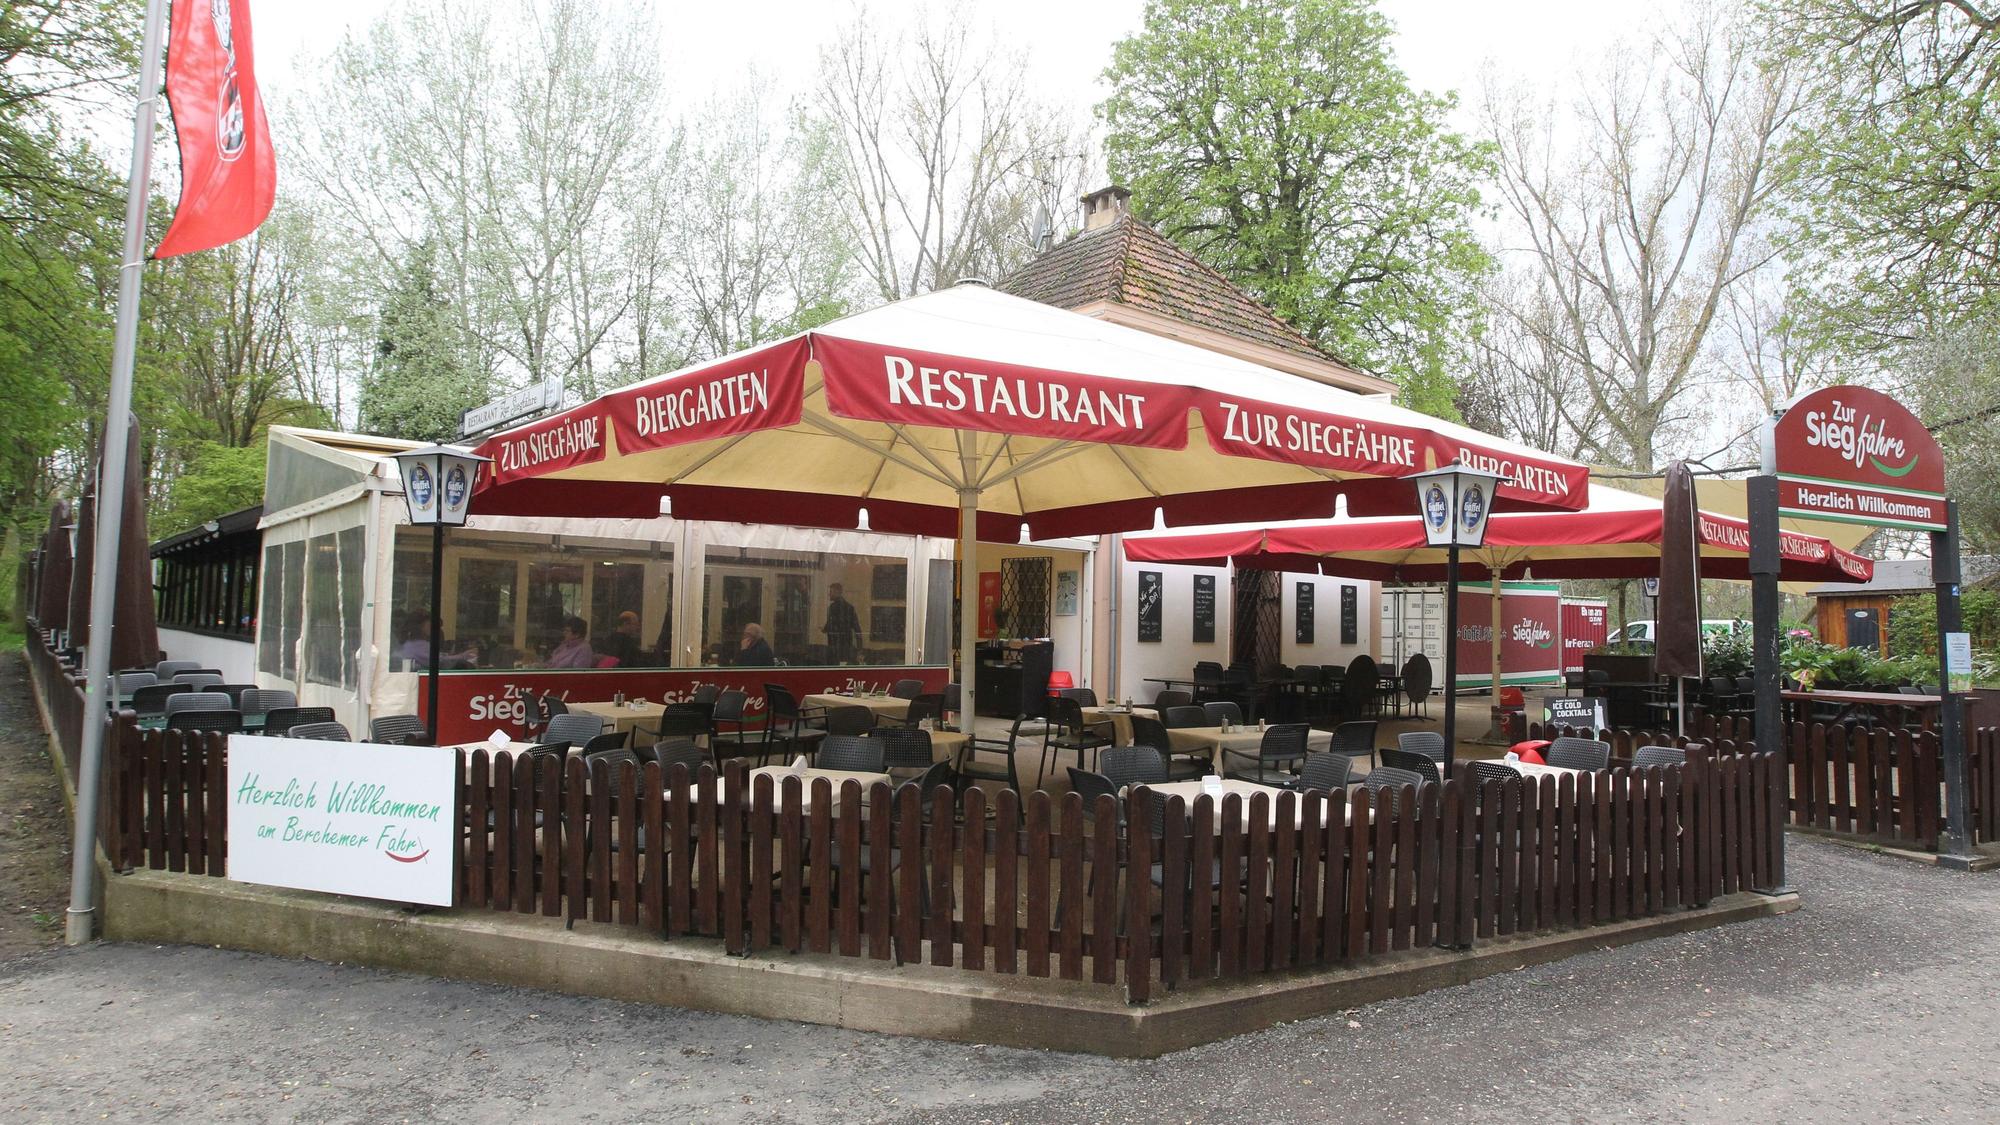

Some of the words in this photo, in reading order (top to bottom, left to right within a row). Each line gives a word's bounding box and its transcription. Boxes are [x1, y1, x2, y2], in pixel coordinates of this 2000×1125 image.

[636, 369, 768, 437] BIERGARTEN
[884, 355, 1145, 430] RESTAURANT
[1831, 400, 1856, 423] Zur
[501, 439, 529, 472] ZUR
[531, 416, 600, 465] SIEGFÄHRE
[1219, 401, 1282, 448] ZUR
[1286, 414, 1415, 468] SIEGFÄHRE
[1460, 447, 1569, 497] BIERGARTEN
[1798, 487, 1854, 510] Herzlich
[1857, 495, 1931, 519] Willkommen
[1700, 516, 1749, 547] RESTAURAN
[1522, 617, 1532, 628] Zur
[1552, 702, 1563, 710] ICE
[1564, 701, 1582, 709] COLD
[1556, 708, 1592, 718] COCKTAILS
[237, 772, 317, 809] Herzlich
[326, 781, 441, 823] Willkommen
[257, 823, 276, 838] am
[282, 816, 369, 848] Berchemer
